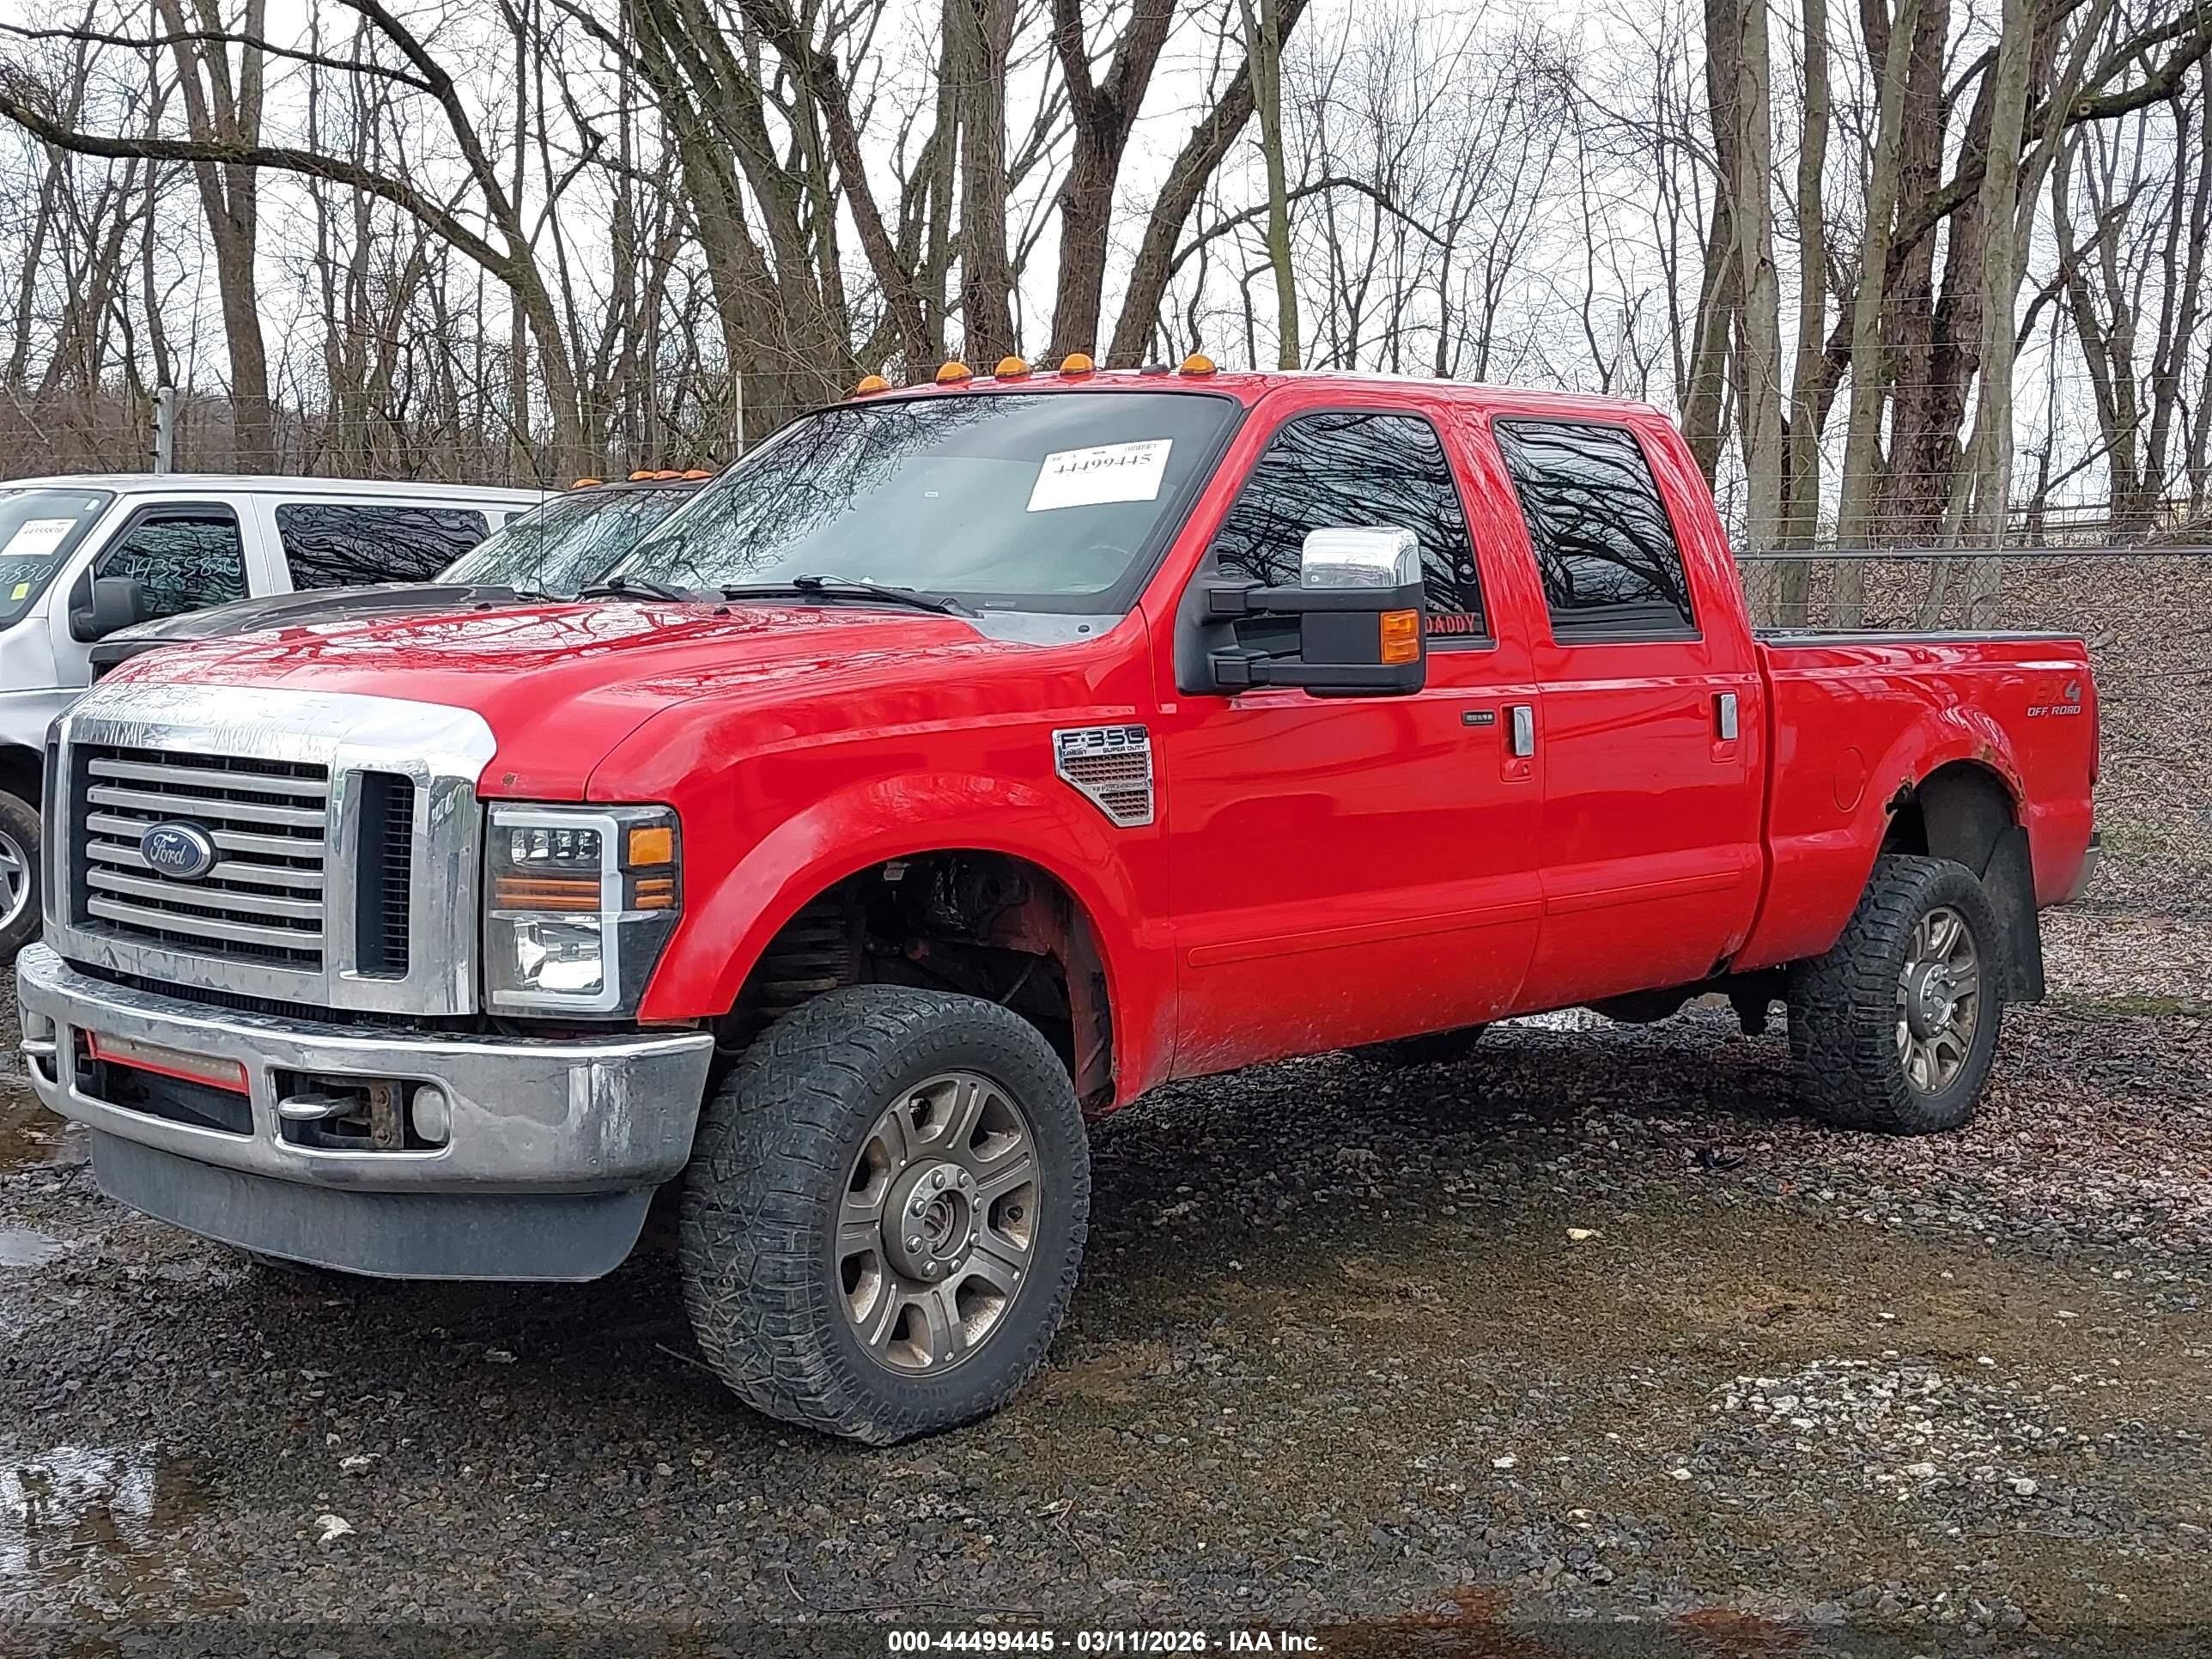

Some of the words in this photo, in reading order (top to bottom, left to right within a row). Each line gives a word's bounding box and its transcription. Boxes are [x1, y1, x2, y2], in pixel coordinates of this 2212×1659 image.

[1054, 453, 1152, 474] 44499445
[2027, 707, 2049, 717] OFF
[2051, 705, 2081, 715] ROAD
[149, 833, 187, 866] Ford
